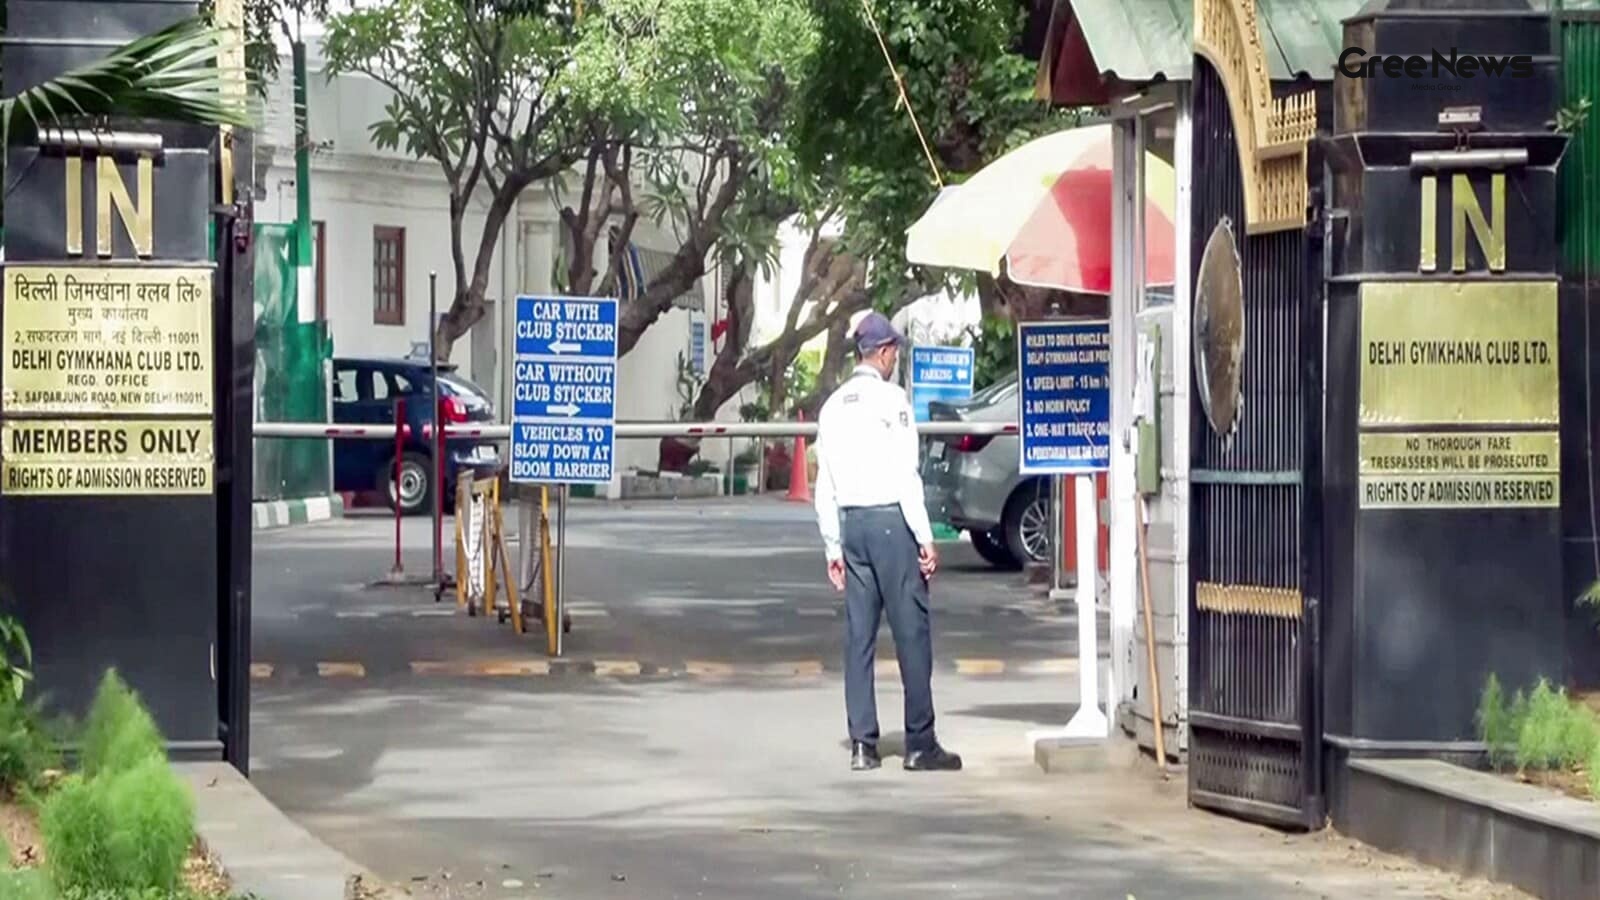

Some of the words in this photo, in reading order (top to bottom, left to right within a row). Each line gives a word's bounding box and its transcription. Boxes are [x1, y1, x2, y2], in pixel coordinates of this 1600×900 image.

[66, 156, 152, 255] IN
[1421, 173, 1506, 272] IN
[15, 273, 57, 301] दिल्ली
[533, 302, 561, 320] CAR
[564, 303, 600, 321] WITH
[517, 320, 552, 339] CLUB
[556, 322, 614, 341] STICKER
[12, 350, 52, 370] DELHI
[56, 350, 133, 370] GYMKHANA
[137, 351, 172, 371] CLUB
[176, 351, 204, 370] LTD.
[1078, 350, 1094, 363] CLUB
[1369, 341, 1406, 365] DELHI
[1410, 341, 1483, 365] GYMKHANA
[1486, 341, 1520, 364] CLUB
[1524, 341, 1551, 364] LTD.
[105, 374, 149, 387] OFFICE
[516, 363, 545, 382] CAR
[548, 364, 613, 383] WITHOUT
[515, 382, 550, 401] CLUB
[554, 384, 612, 403] STICKER
[1033, 376, 1055, 391] SPEED
[1056, 376, 1074, 390] LIMIT
[120, 391, 141, 404] NEW
[1033, 400, 1045, 414] NO
[1045, 399, 1065, 414] HORN
[1066, 398, 1091, 413] POLICY
[521, 426, 583, 441] VEHICLES
[586, 428, 604, 442] TO
[1067, 421, 1095, 436] TRAFFIC
[12, 429, 127, 454] MEMBERS
[140, 429, 200, 454] ONLY
[1406, 439, 1420, 450] NO
[1427, 438, 1481, 450] THOROUGH
[1488, 437, 1512, 449] FARE
[514, 443, 549, 458] SLOW
[553, 444, 590, 460] DOWN
[593, 445, 610, 460] AT
[514, 461, 550, 476] BOOM
[554, 462, 611, 477] BARRIER
[1371, 456, 1439, 469] TRESPASSERS
[1442, 456, 1464, 469] WILL
[1468, 456, 1480, 469] BE
[1484, 454, 1548, 468] PROSECUTED
[9, 467, 53, 488] RIGHTS
[57, 468, 72, 488] OF
[75, 468, 141, 488] ADMISSION
[145, 467, 206, 488] RESERVED
[1366, 482, 1408, 502] RIGHTS
[1411, 482, 1426, 501] OF
[1429, 481, 1491, 501] ADMISSION
[1494, 479, 1553, 500] RESERVED
